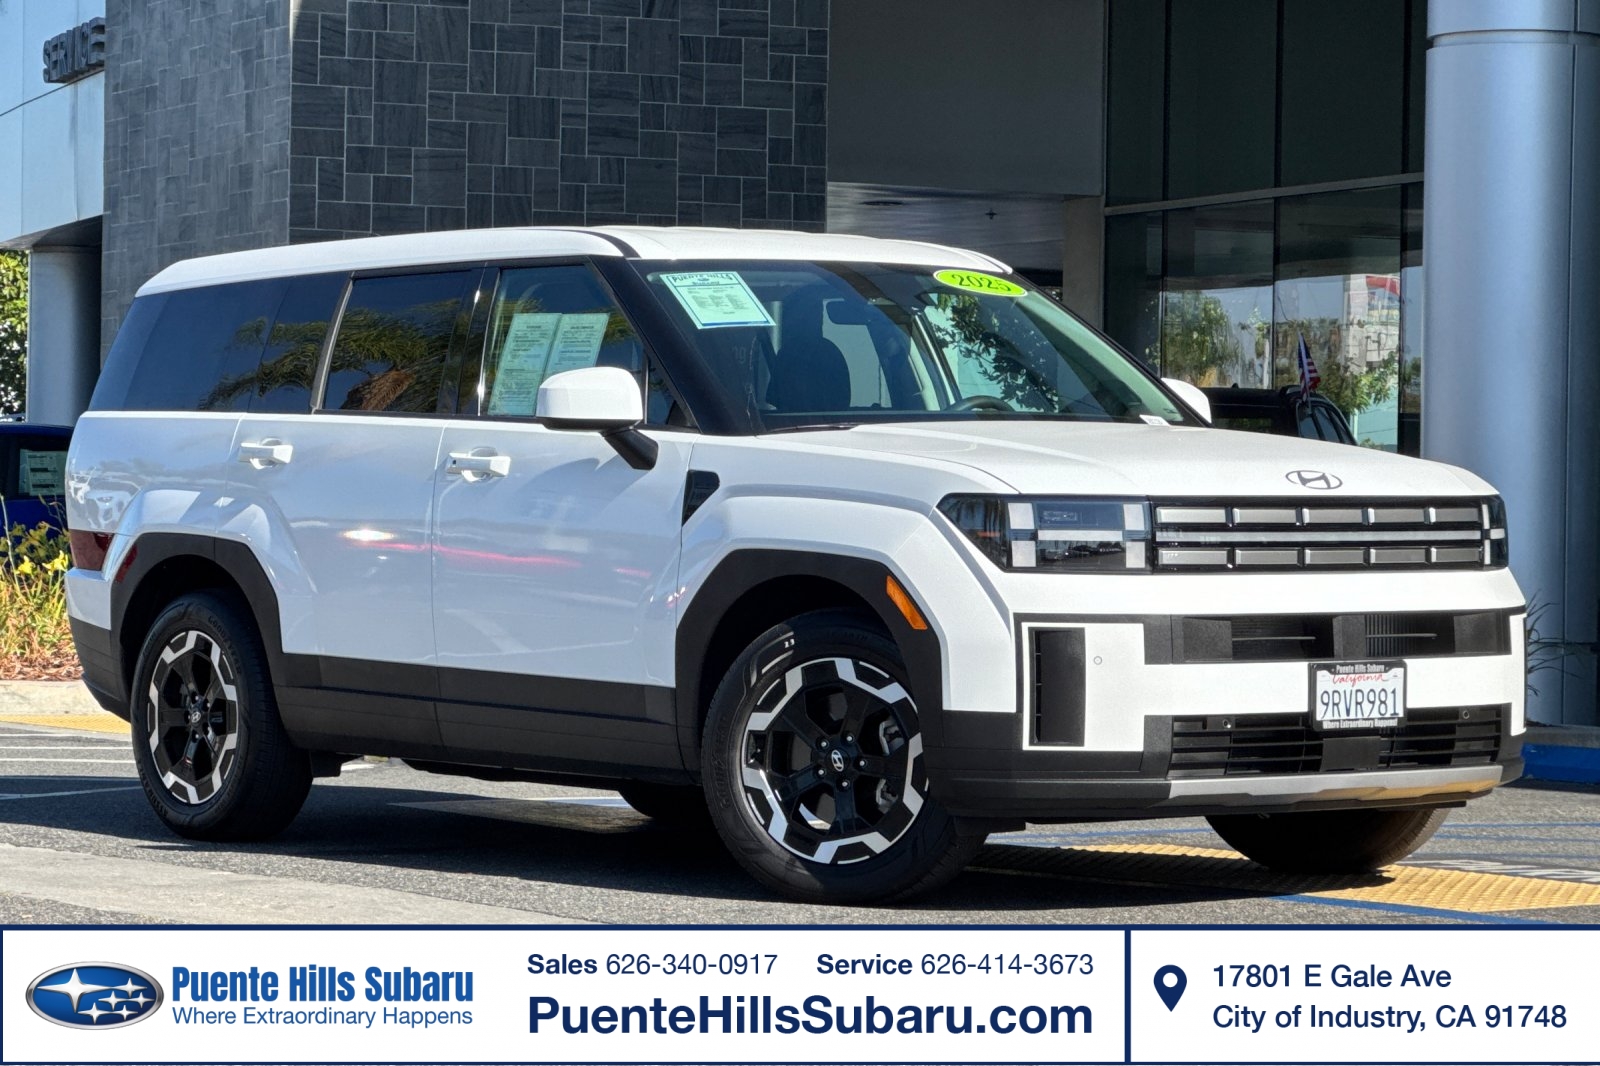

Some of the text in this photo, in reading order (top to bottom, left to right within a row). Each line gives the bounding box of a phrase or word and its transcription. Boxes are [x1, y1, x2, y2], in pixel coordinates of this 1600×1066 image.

[43, 17, 105, 83] SERVICE
[951, 273, 1012, 292] 2025
[1335, 663, 1385, 674] Puente Hills Subaru
[1332, 673, 1389, 687] California
[1320, 687, 1400, 719] 9RVR981
